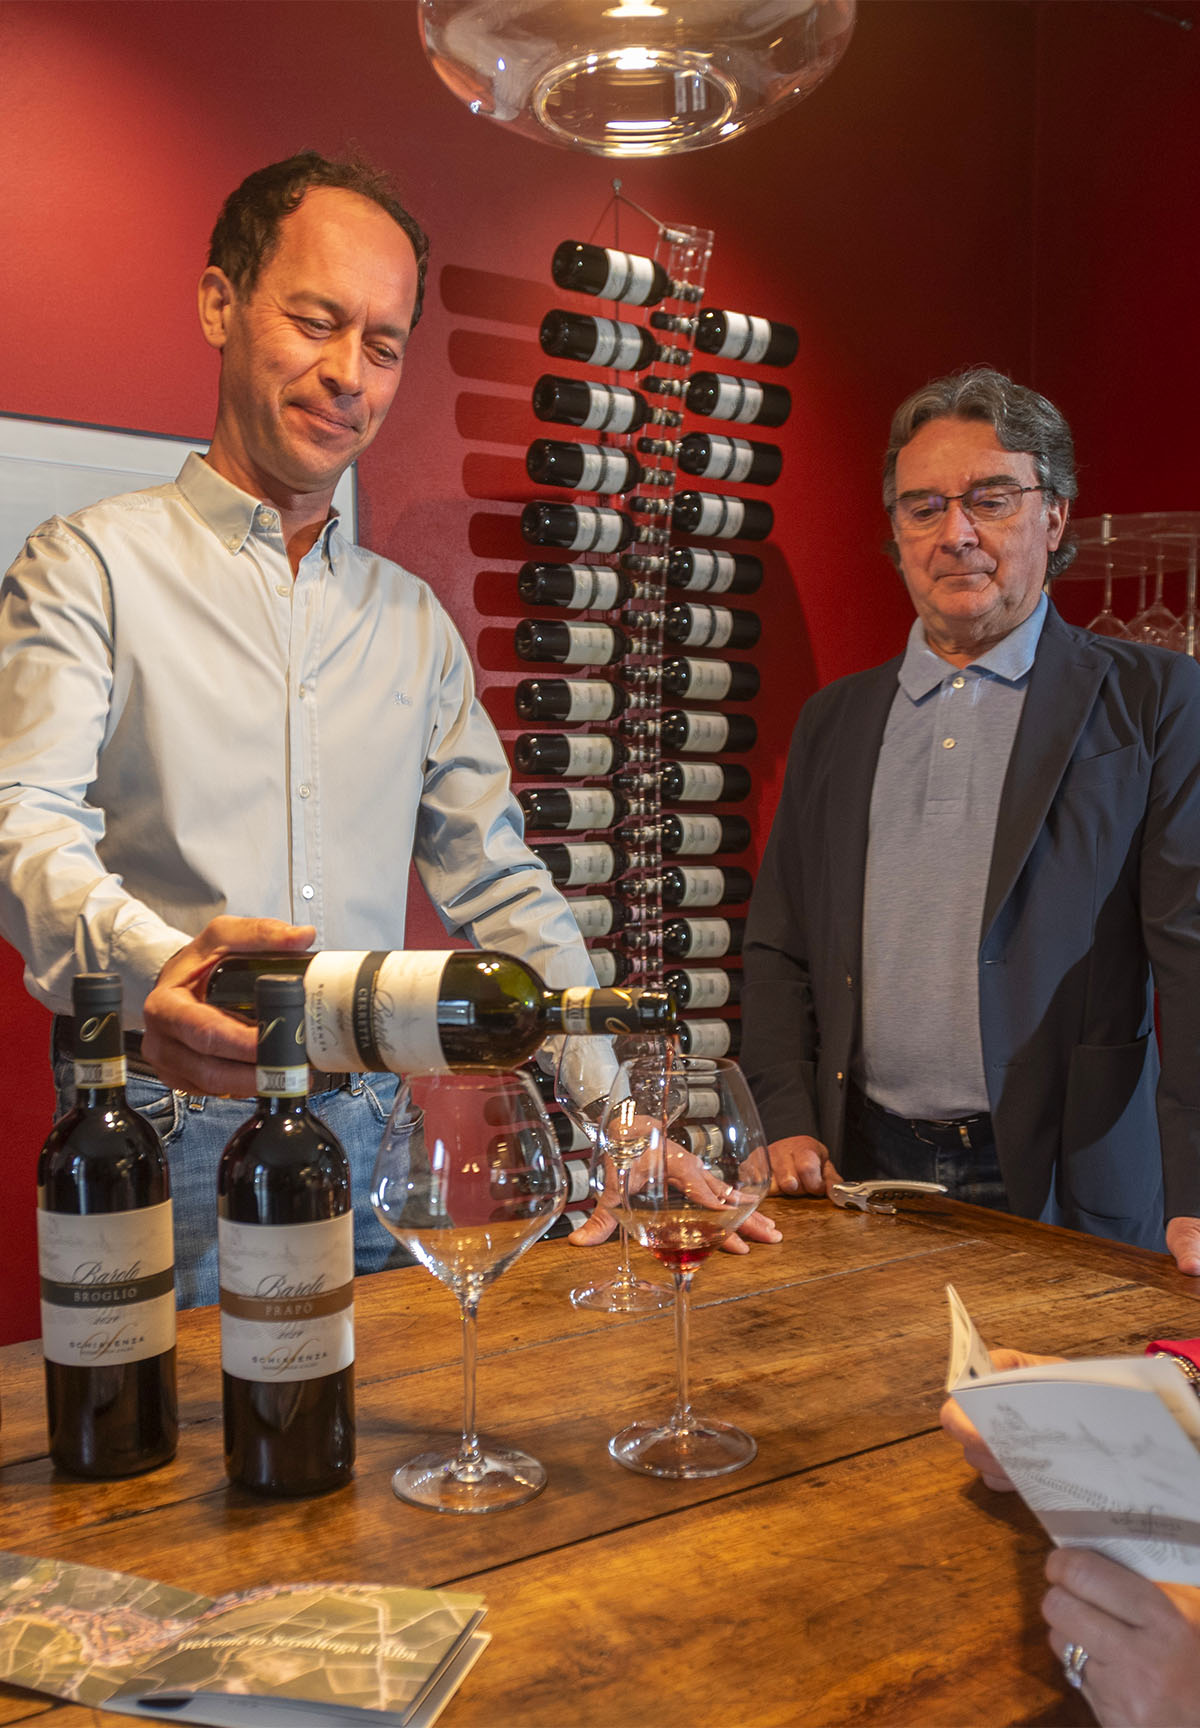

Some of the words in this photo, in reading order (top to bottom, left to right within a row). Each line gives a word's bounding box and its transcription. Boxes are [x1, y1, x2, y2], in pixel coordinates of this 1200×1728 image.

[358, 987, 371, 1049] CERRETTA
[73, 1287, 138, 1303] BROGLIO
[177, 1637, 245, 1651] Welcome
